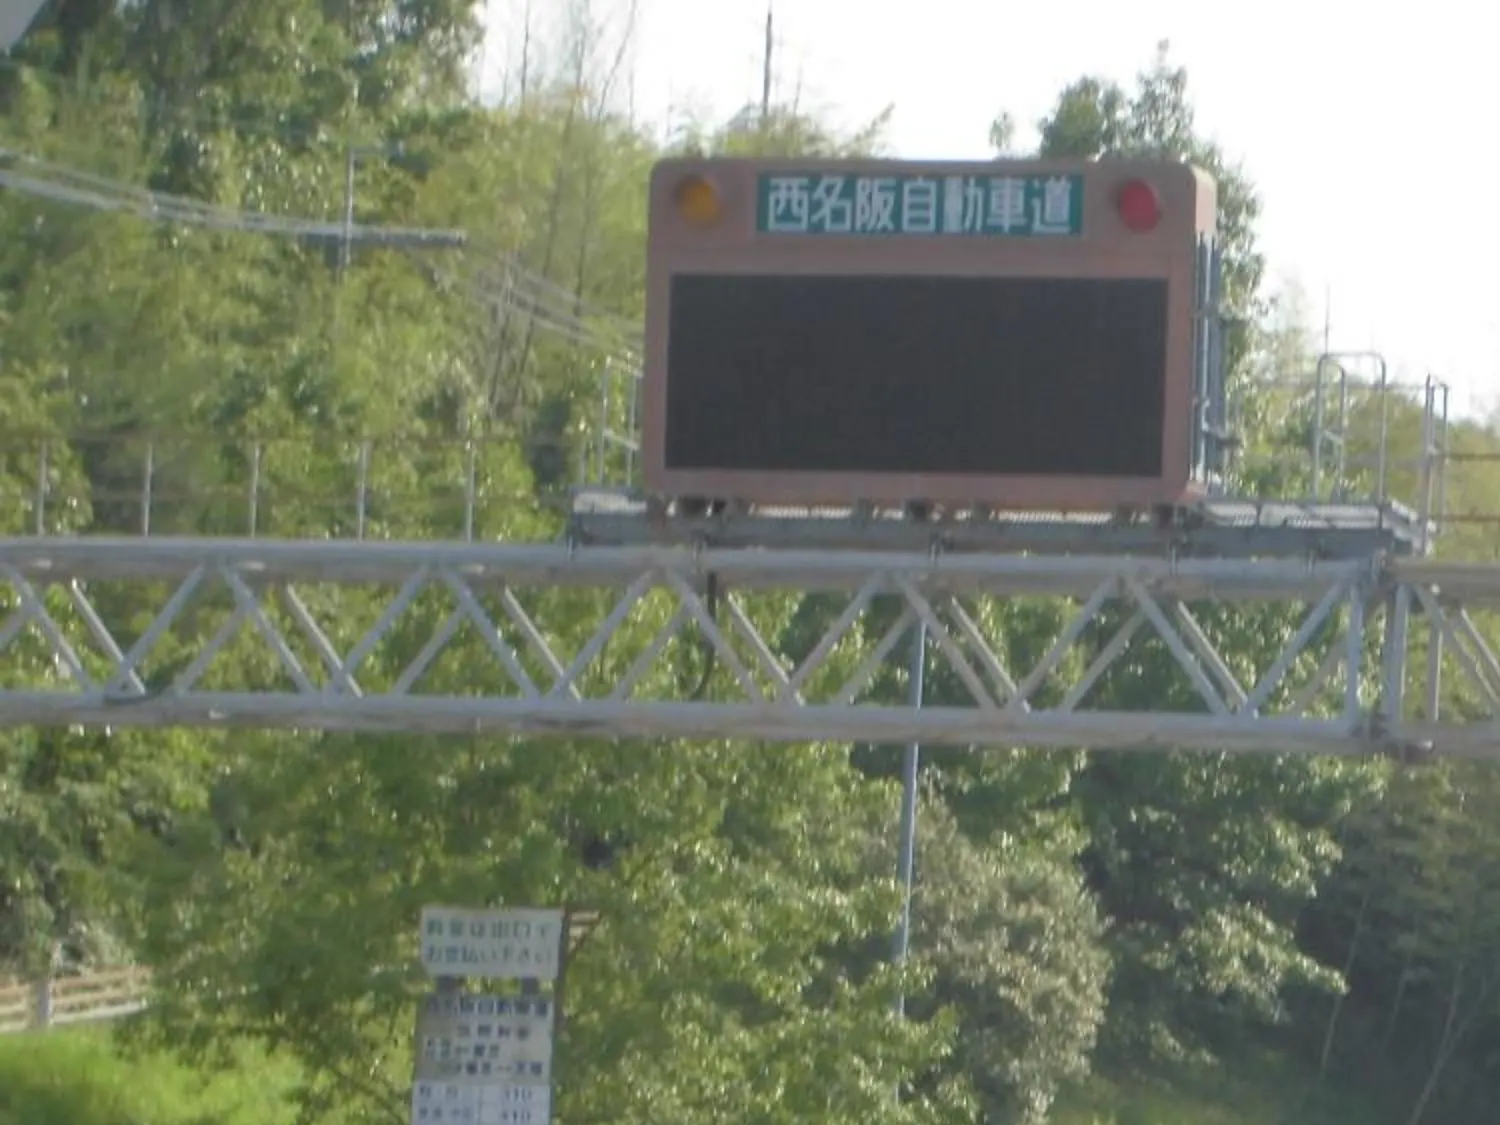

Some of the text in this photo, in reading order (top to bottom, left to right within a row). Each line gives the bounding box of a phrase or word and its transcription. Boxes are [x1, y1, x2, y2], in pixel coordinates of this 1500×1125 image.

[768, 175, 1072, 233] 西名阪自動車道
